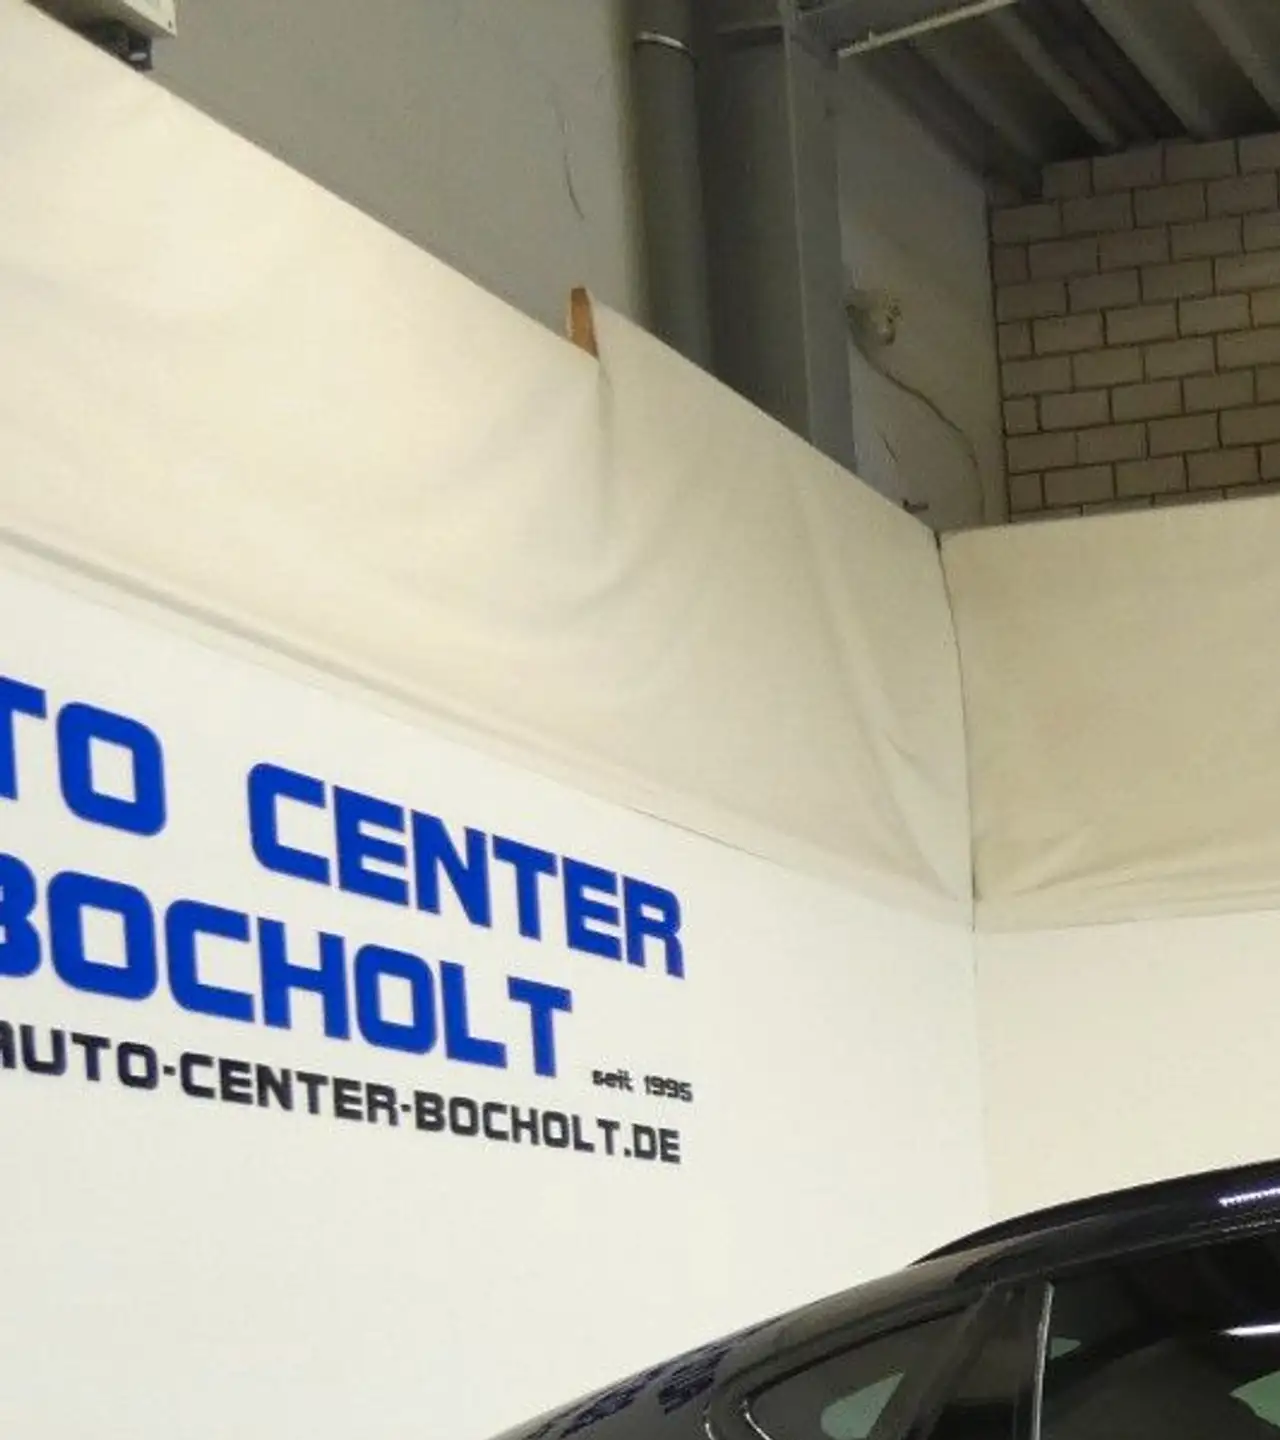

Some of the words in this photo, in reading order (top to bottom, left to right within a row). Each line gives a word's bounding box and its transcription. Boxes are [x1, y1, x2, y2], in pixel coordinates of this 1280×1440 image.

[248, 764, 683, 977] CENTER
[593, 1070, 632, 1091] seit
[644, 1076, 692, 1102] 1995
